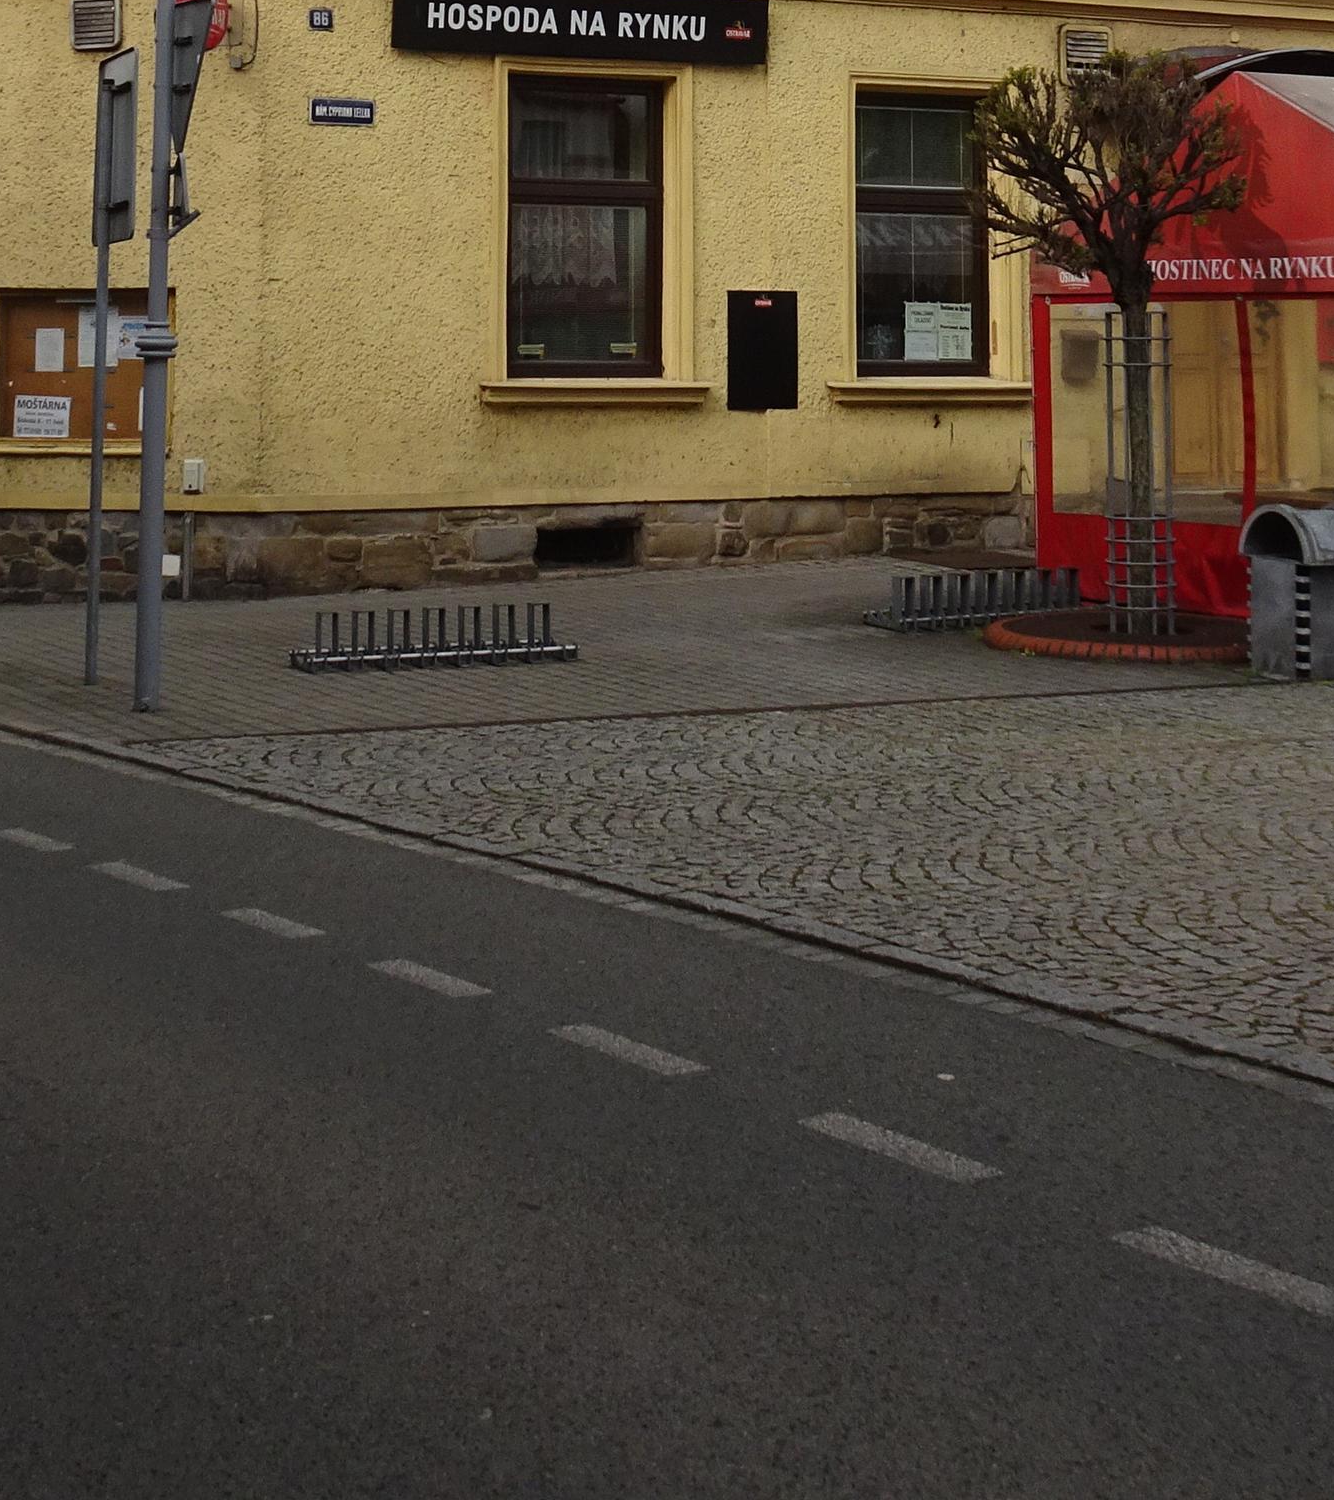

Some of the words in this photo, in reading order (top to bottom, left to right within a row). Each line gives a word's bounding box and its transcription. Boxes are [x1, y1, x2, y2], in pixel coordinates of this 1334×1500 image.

[313, 11, 329, 26] 86
[427, 2, 558, 35] HOSPODA
[569, 9, 606, 37] NA
[617, 11, 706, 41] RYNKU
[1240, 258, 1267, 280] NA
[17, 398, 67, 410] MOŠTÁRNA
